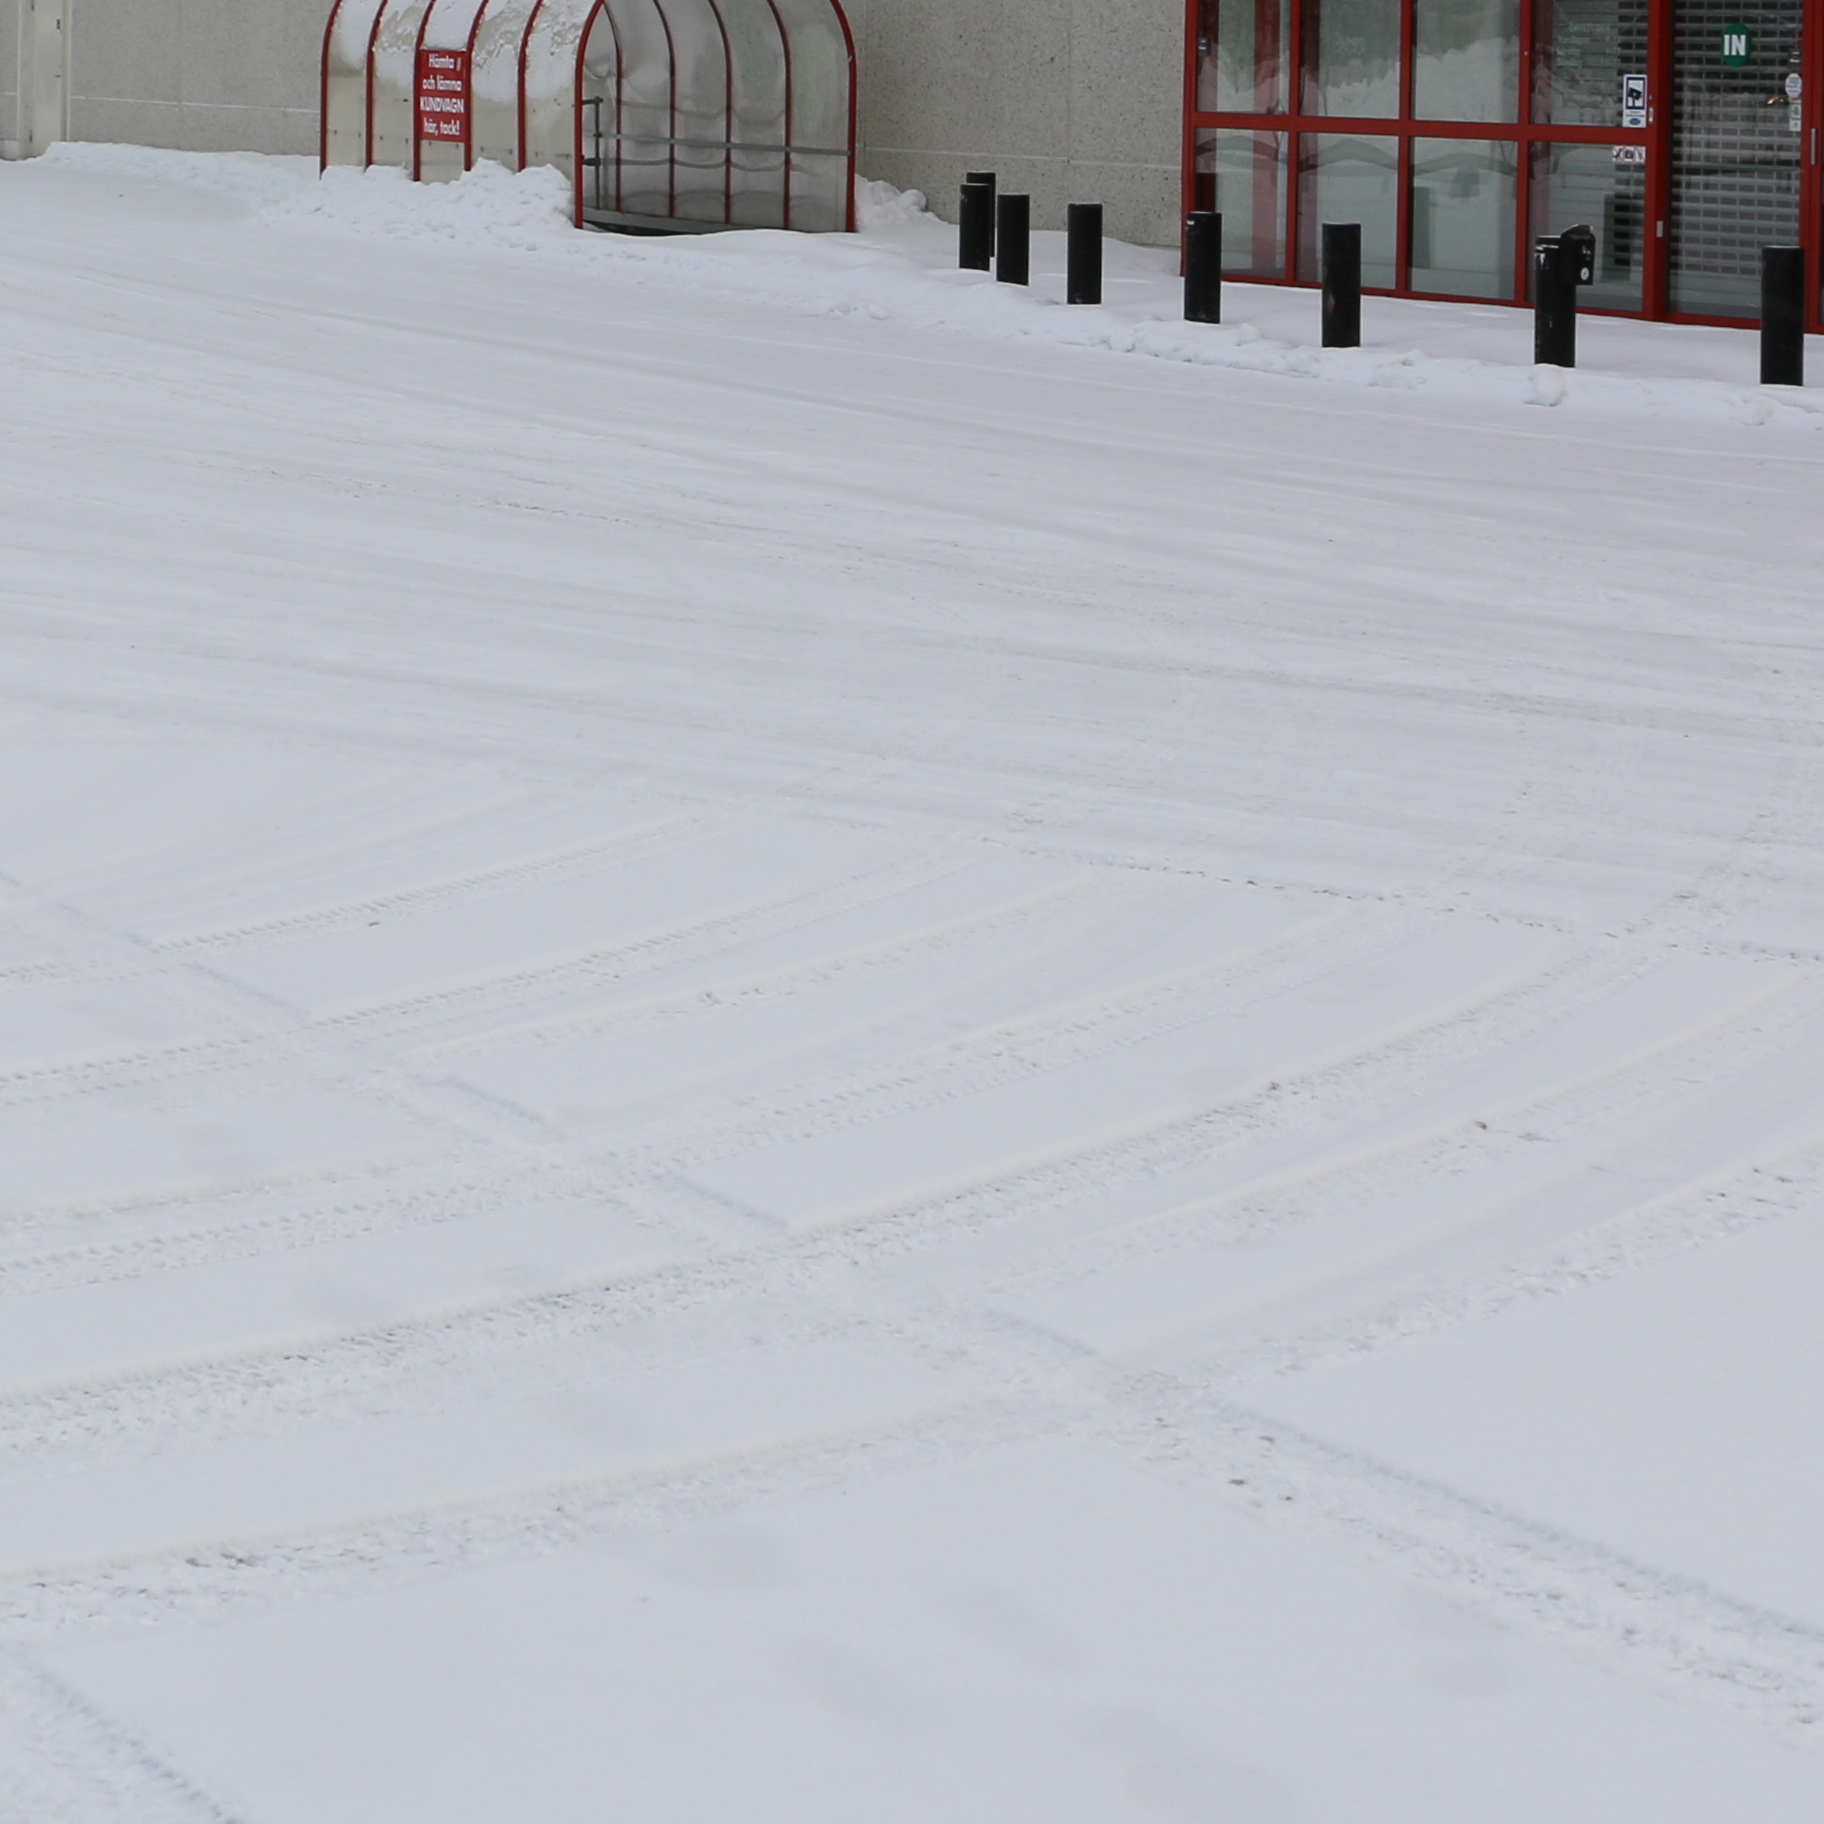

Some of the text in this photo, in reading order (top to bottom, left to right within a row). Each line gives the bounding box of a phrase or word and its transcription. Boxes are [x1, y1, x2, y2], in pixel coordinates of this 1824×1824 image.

[1724, 34, 1746, 56] IN
[429, 53, 454, 69] Hämta
[422, 75, 462, 91] och lämna
[420, 96, 464, 113] KUNDVAGN
[440, 119, 460, 135] tack!
